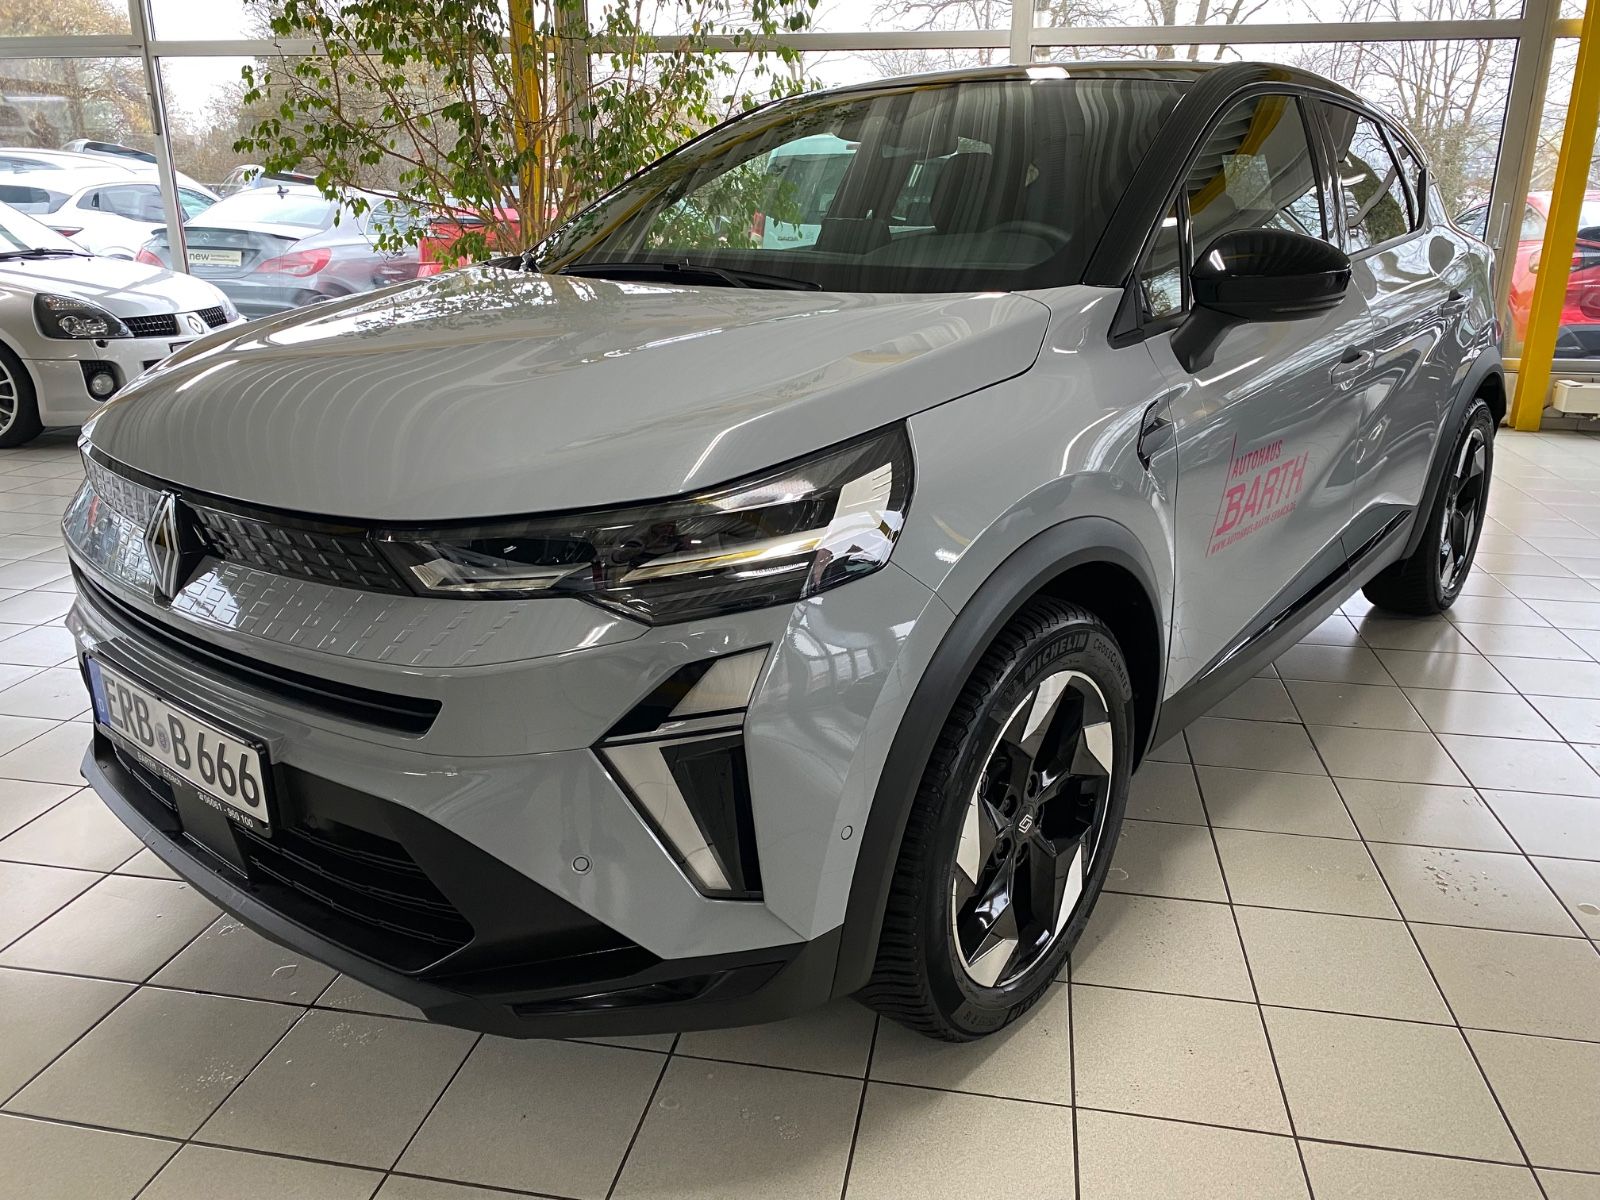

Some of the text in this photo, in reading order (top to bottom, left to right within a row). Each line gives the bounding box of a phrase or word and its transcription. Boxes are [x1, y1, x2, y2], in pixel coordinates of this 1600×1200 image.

[189, 252, 210, 261] new
[1231, 439, 1284, 479] AUTOHAUS
[1214, 449, 1309, 537] BARTH
[1024, 632, 1088, 682] MICHELIN
[104, 679, 260, 808] ERB B 666
